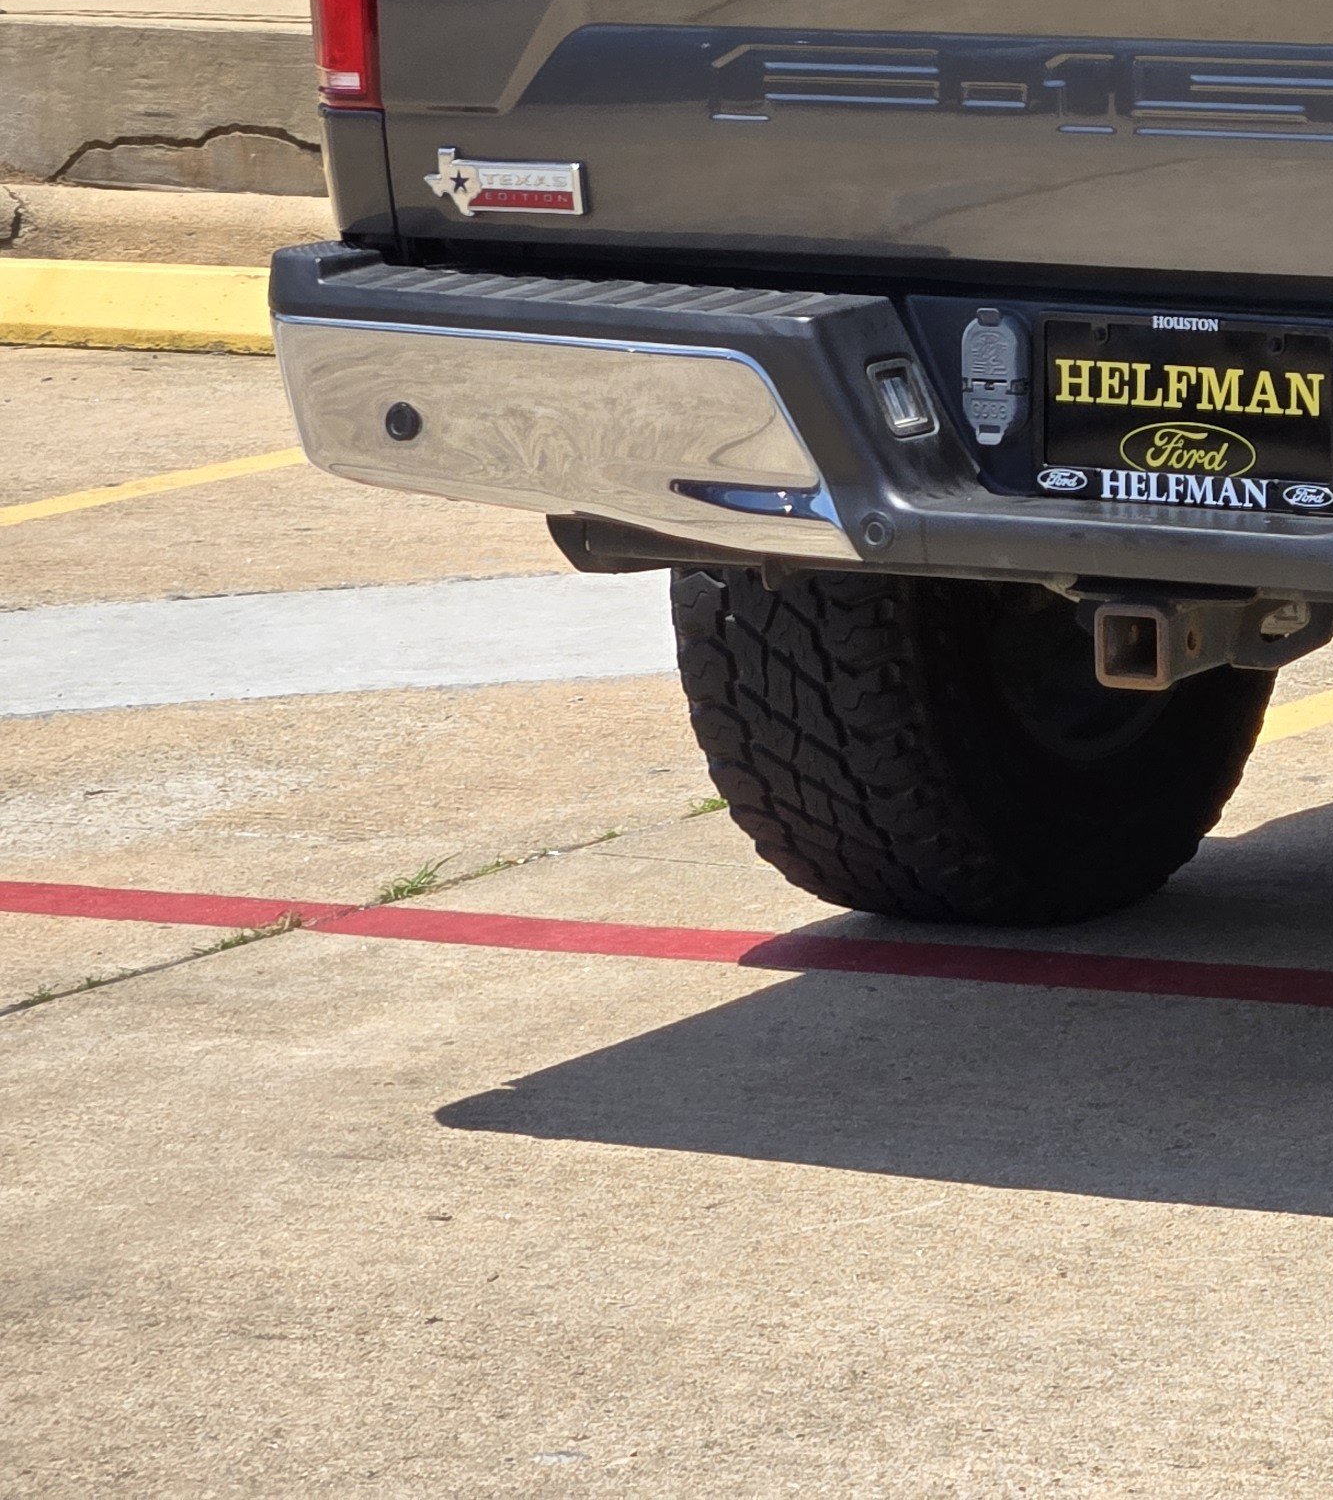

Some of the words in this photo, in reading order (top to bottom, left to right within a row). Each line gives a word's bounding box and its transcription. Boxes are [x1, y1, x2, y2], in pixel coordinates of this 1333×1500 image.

[481, 173, 568, 188] TEXAS
[484, 191, 569, 204] EDITION
[1152, 314, 1219, 332] HOUSTON
[1054, 357, 1326, 418] HELFMAN
[1145, 427, 1229, 472] Ford
[1099, 468, 1270, 509] HELFMAN
